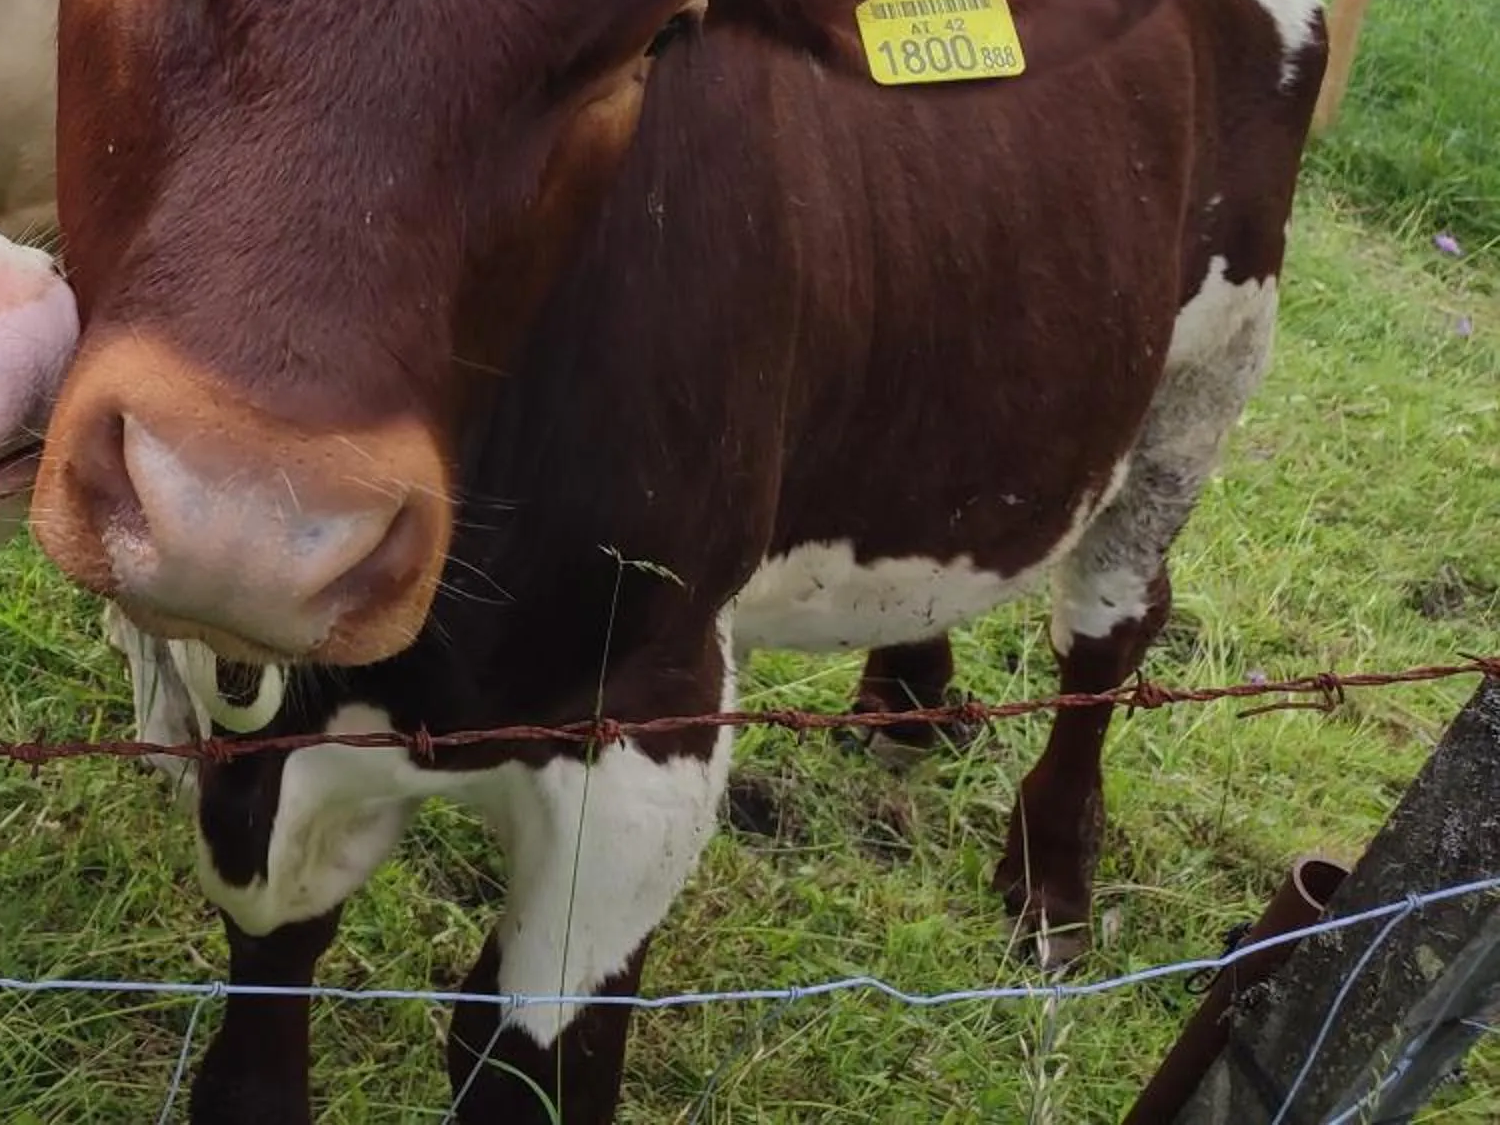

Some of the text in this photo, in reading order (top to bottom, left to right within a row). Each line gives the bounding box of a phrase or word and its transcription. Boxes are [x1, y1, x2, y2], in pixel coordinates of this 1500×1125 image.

[911, 19, 965, 35] AT 42
[878, 34, 1017, 76] 1800 888
